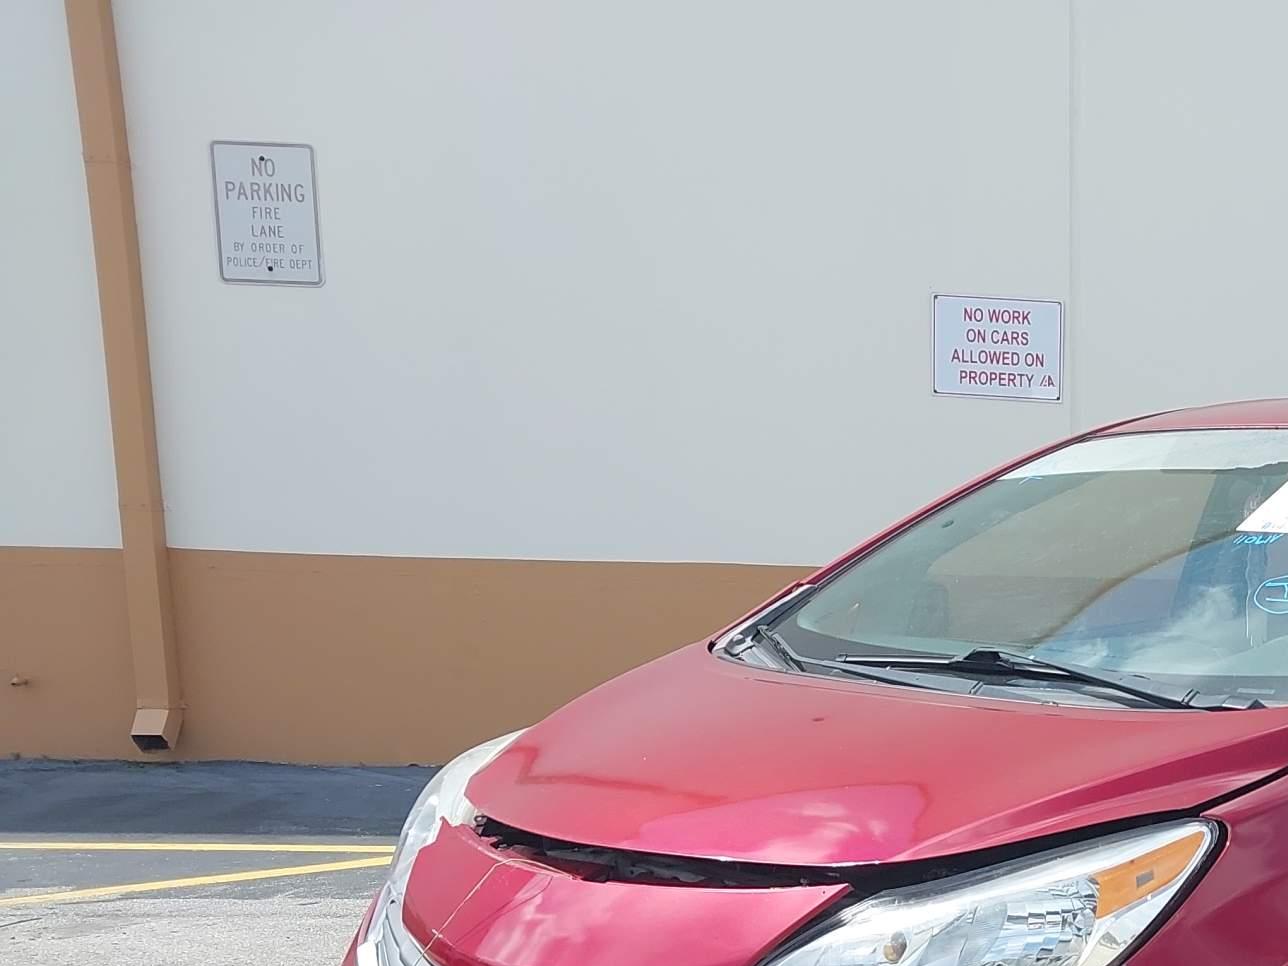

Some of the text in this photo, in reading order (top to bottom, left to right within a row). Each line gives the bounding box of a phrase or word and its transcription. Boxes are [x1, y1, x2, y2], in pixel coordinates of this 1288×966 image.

[251, 157, 276, 177] NO
[224, 181, 306, 203] PARKING
[251, 206, 281, 220] FIRE
[251, 224, 285, 238] LANE
[233, 241, 304, 254] BY ORDER OF
[226, 256, 313, 270] POLICE/FIRE DEPT
[963, 307, 1032, 326] NO WORK
[966, 328, 1030, 346] ON CARS
[951, 348, 1045, 368] ALLOWED ON
[959, 369, 1035, 389] PROPERTY
